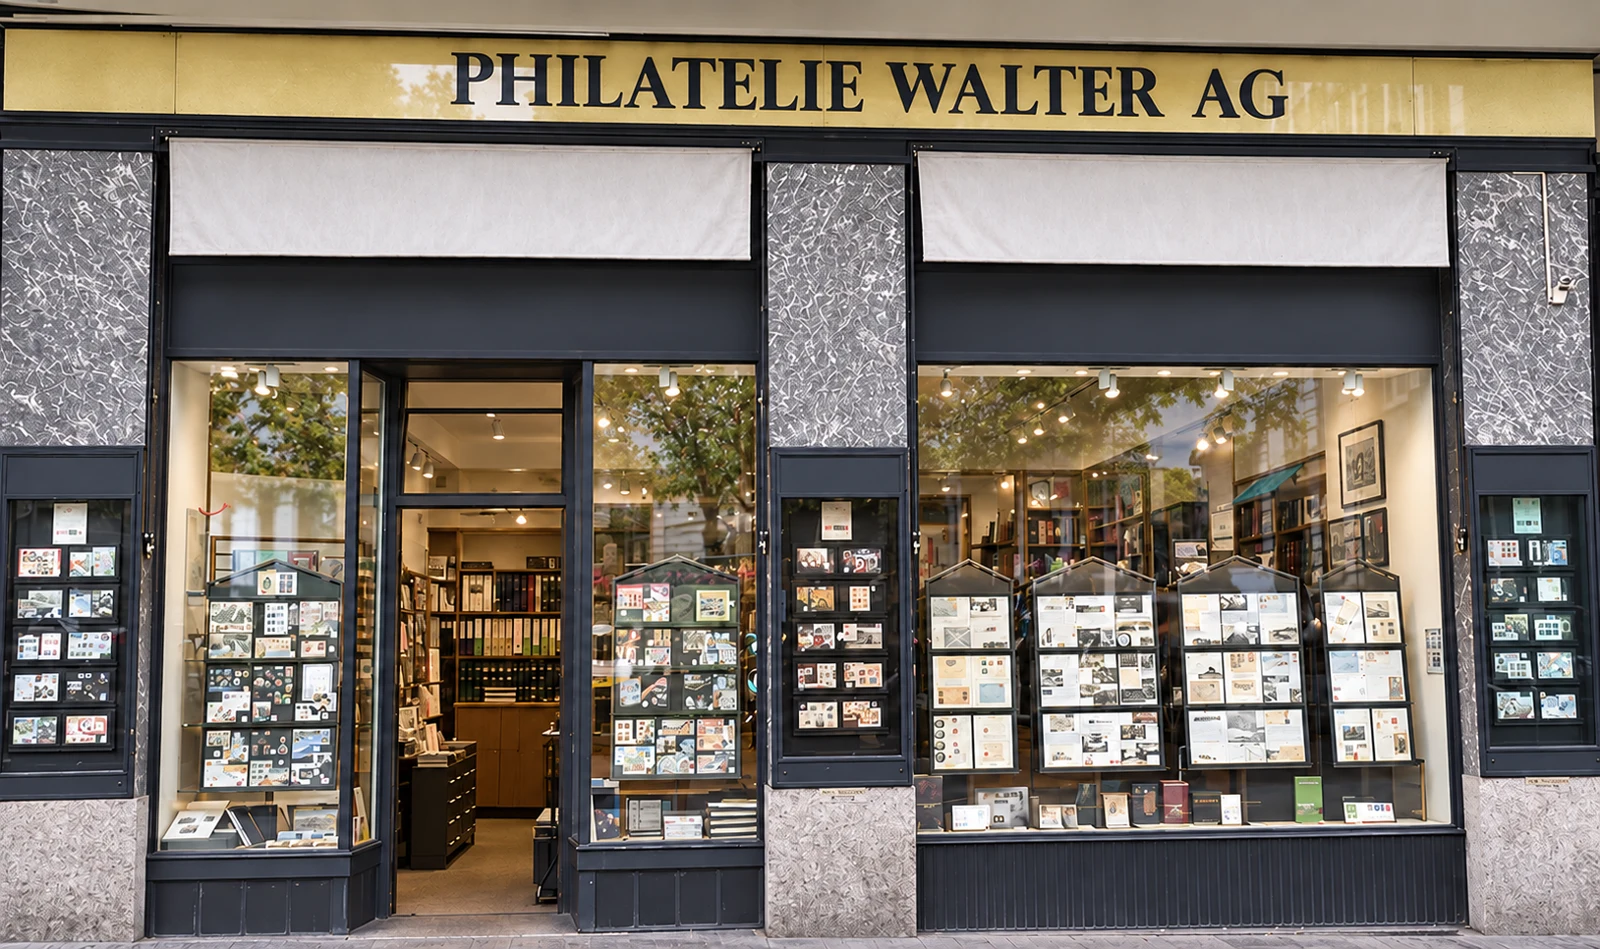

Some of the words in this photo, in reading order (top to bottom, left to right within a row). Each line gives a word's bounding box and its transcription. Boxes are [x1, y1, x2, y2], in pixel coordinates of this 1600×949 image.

[451, 51, 864, 112] PHILATELIE
[886, 61, 1165, 119] WALTER
[1192, 68, 1289, 120] AG
